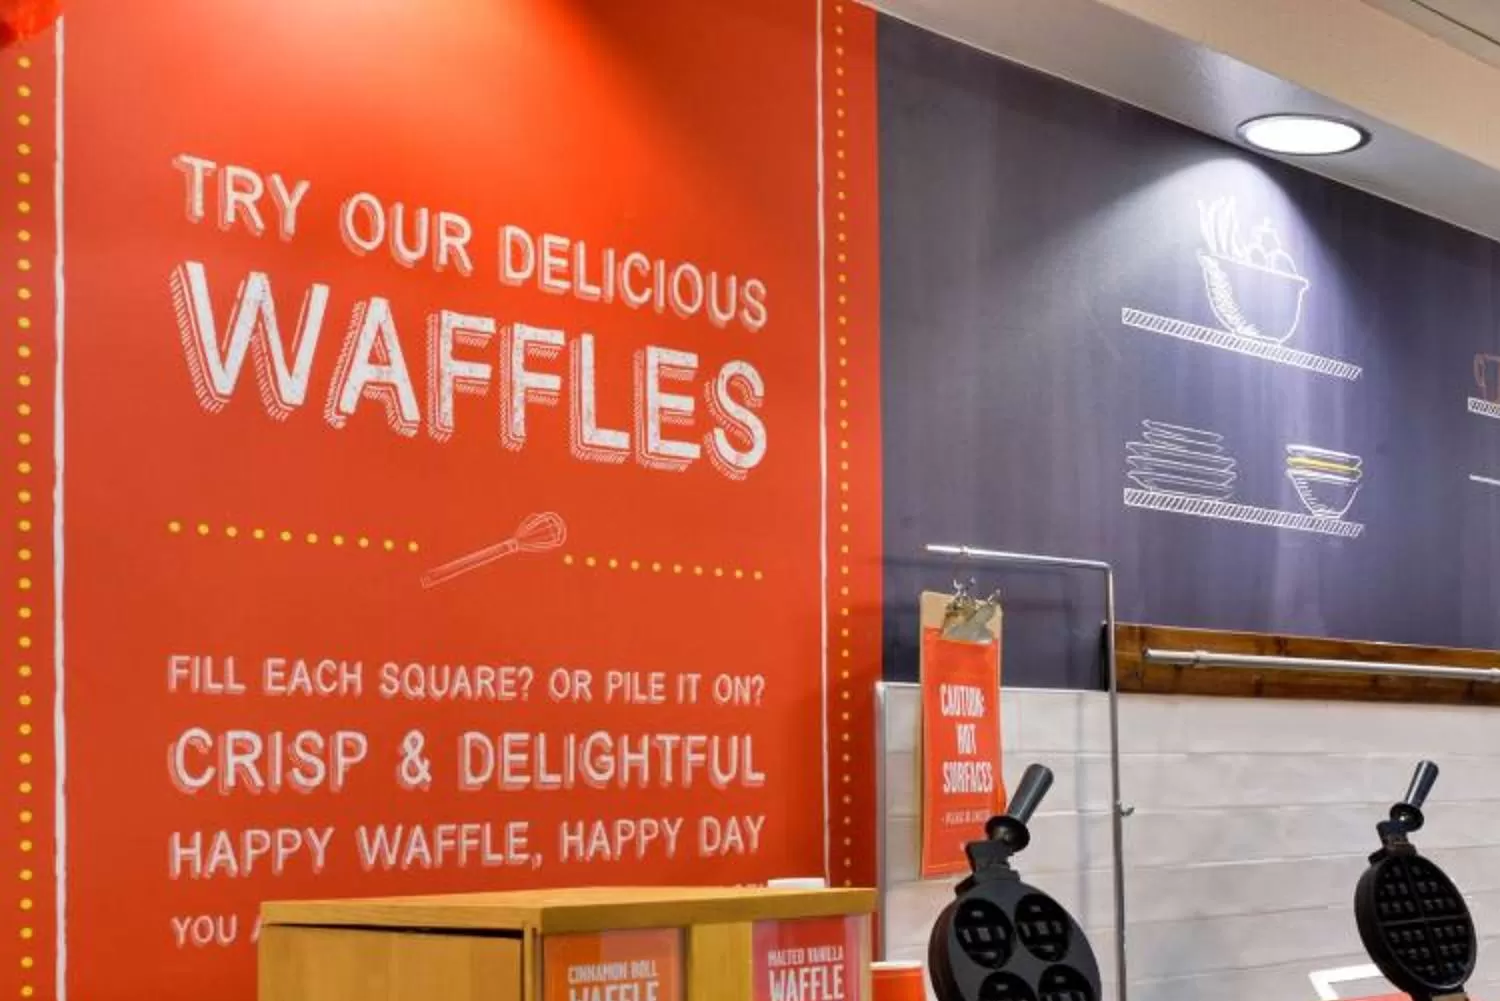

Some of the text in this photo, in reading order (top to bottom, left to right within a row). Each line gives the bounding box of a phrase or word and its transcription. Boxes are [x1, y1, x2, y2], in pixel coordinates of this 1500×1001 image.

[172, 153, 767, 333] TRY OUR DELICIOUS
[170, 260, 767, 481] WAFFLES
[167, 655, 766, 707] FILL EACH SQUARE? OR PILE IT ON?
[956, 723, 977, 755] HOT
[167, 727, 766, 796] CRISP & DELIGHTFUL
[943, 761, 993, 793] SURFACES
[168, 815, 766, 880] HAPPY WAFFLE, HAPPY DAY
[171, 914, 238, 945] YOU
[567, 959, 659, 984] CINNAMON ROLL
[767, 945, 843, 967] MALTED VANILLA
